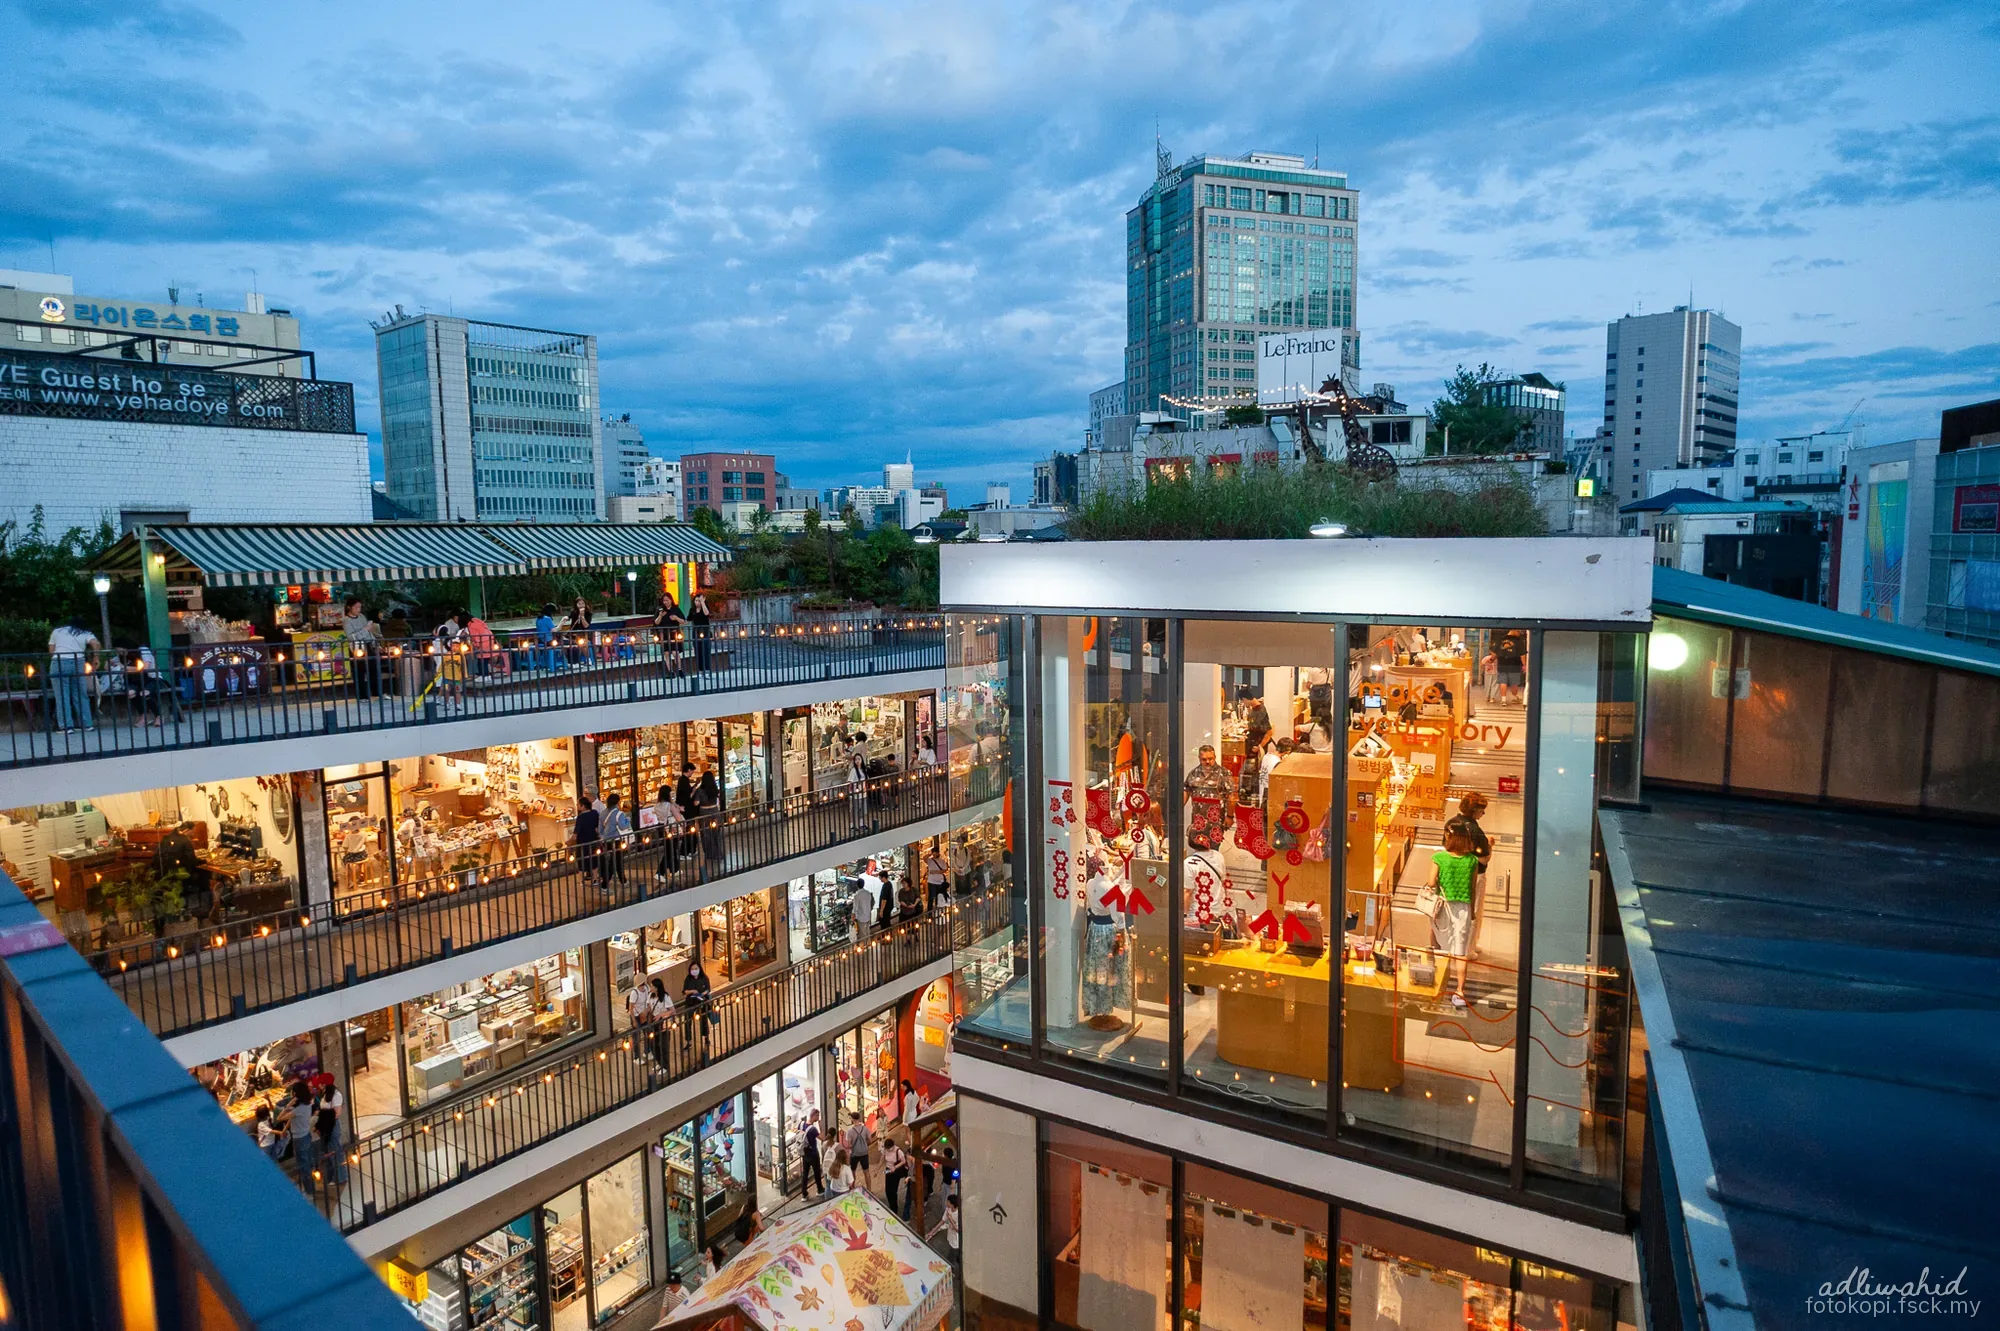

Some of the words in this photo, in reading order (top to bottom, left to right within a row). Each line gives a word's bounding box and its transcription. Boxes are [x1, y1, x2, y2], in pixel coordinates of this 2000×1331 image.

[73, 303, 240, 337] 라이온스회관
[41, 367, 121, 391] Guest
[1357, 678, 1441, 704] make
[1359, 714, 1424, 738] your
[1432, 716, 1513, 750] story
[1398, 804, 1445, 822] 작품들을
